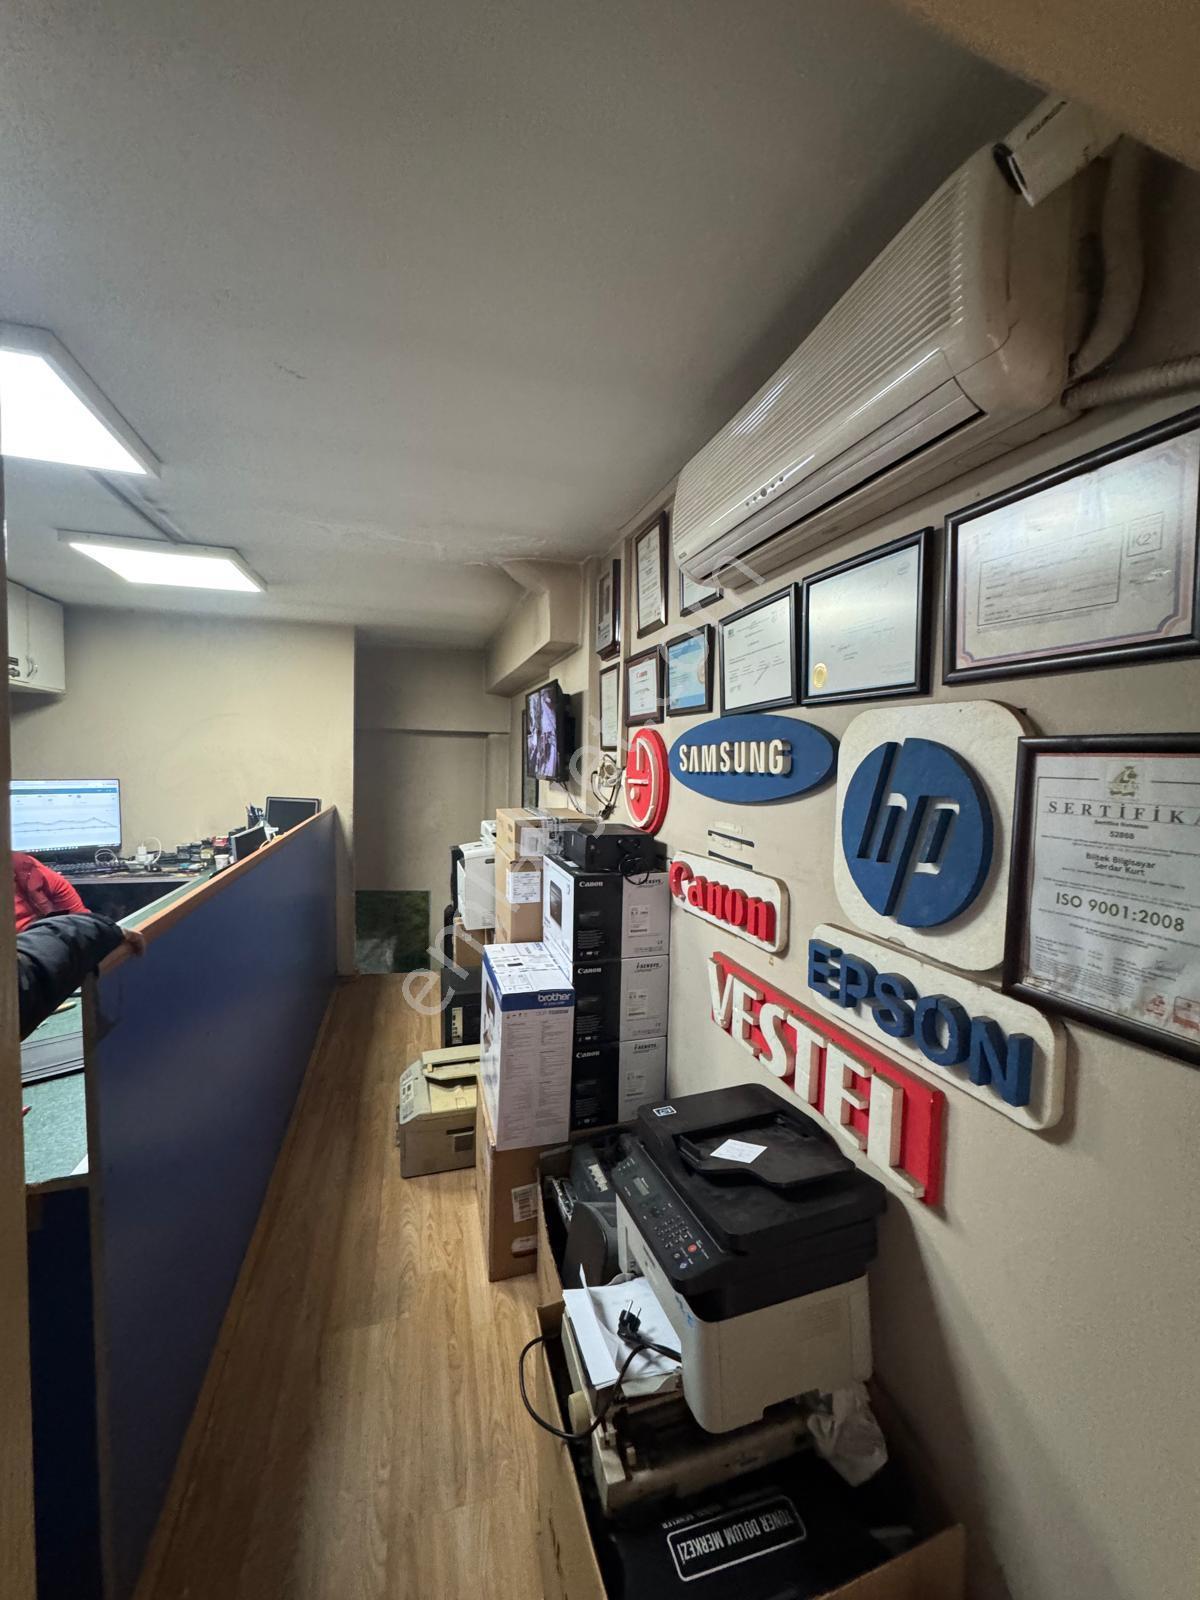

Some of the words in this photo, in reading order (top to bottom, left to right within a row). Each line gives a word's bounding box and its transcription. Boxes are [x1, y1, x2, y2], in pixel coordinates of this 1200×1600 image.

[679, 739, 786, 775] SAMSUNG
[1125, 868, 1145, 876] Kurt
[668, 861, 776, 946] Canon
[1056, 892, 1082, 908] ISO
[1088, 899, 1185, 932] 9001:2008
[537, 993, 571, 1002] brother
[808, 939, 1033, 1107] EPSON
[576, 1050, 600, 1059] Canon
[707, 957, 925, 1199] VESTEL
[723, 1519, 761, 1545] DOLUM
[759, 1509, 794, 1533] TONER
[676, 1530, 725, 1565] MERKEZİ
